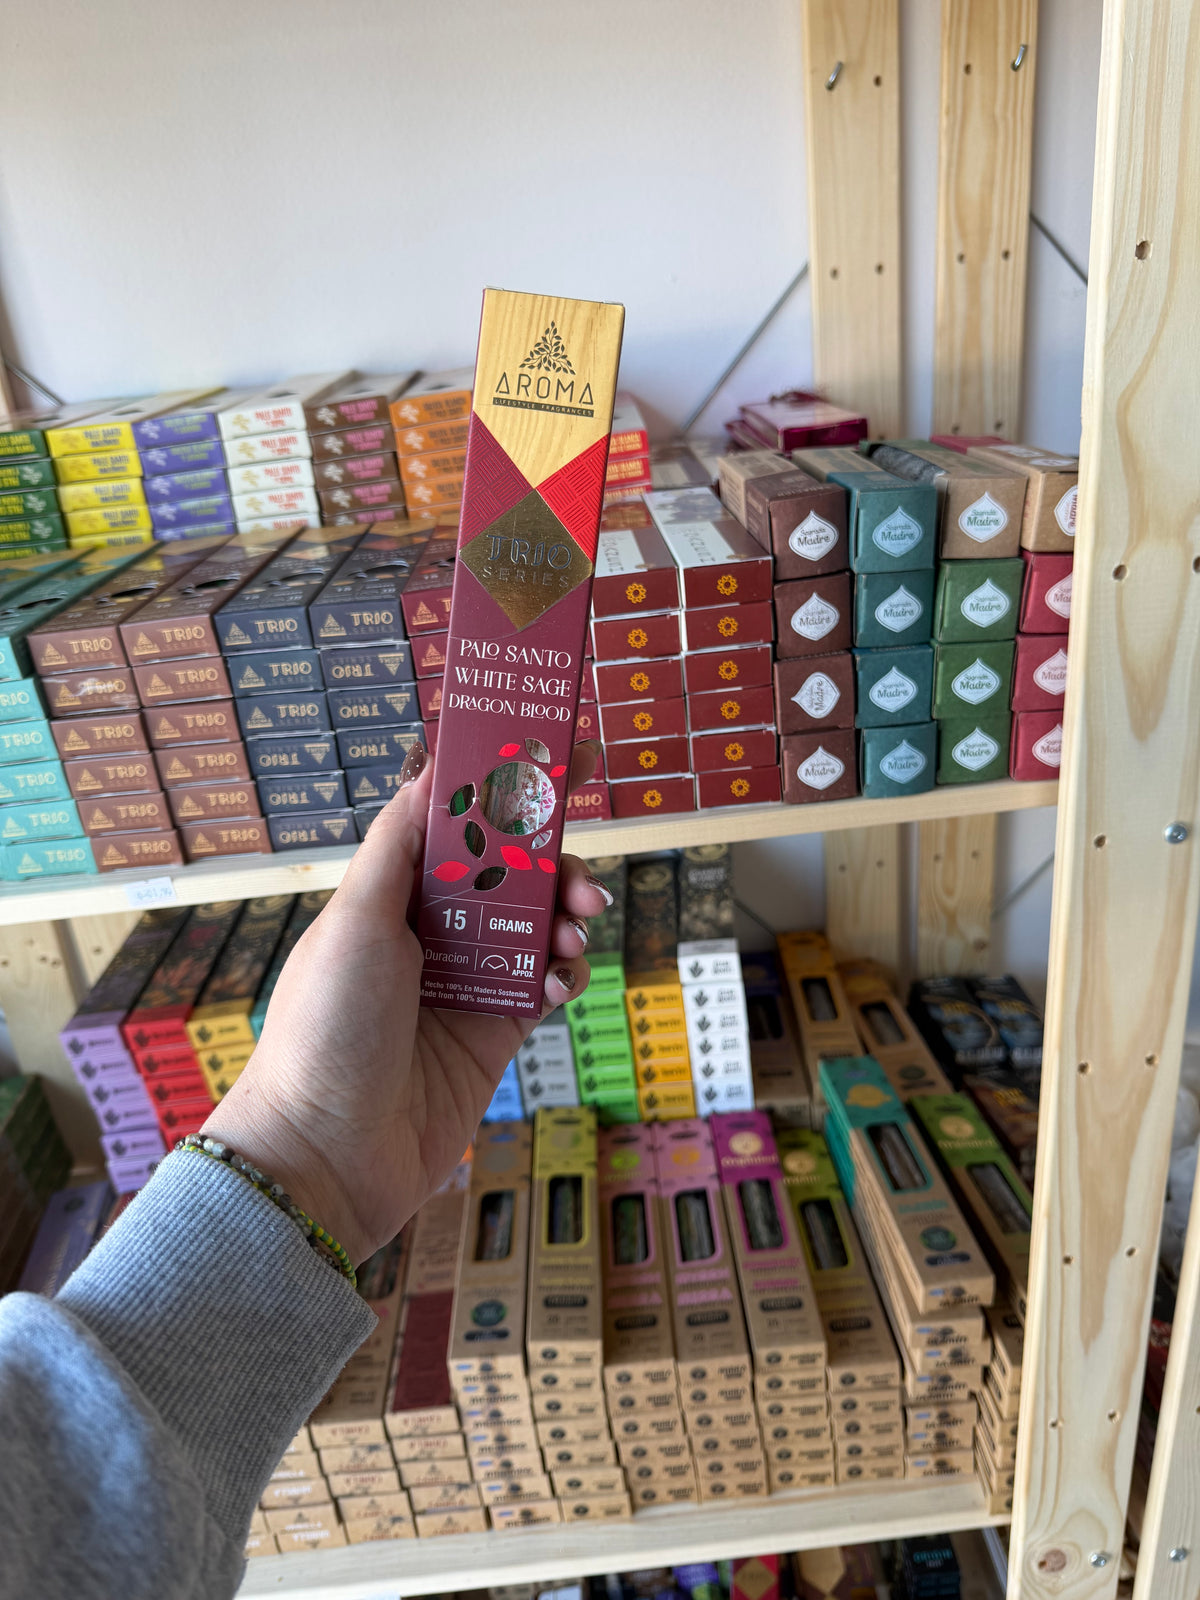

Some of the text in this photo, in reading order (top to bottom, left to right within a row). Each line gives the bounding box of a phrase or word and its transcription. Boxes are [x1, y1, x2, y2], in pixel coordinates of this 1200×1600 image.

[495, 371, 593, 405] AROMA
[494, 398, 592, 416] LIFESTYLE FRAGRANCES
[966, 516, 1000, 527] Madre
[797, 535, 831, 547] Madre
[881, 531, 915, 542] Madre
[486, 534, 572, 569] TRIO
[482, 565, 570, 588] SERIES
[883, 608, 915, 619] Madre
[969, 602, 1001, 612] Madre
[254, 618, 298, 634] TRIO
[350, 611, 394, 627] TRIO
[799, 615, 831, 627] Madre
[161, 625, 205, 643] TRIO
[67, 637, 113, 654] TRIO
[460, 639, 571, 669] PALO SANTO
[174, 667, 219, 684] TRIO
[268, 660, 312, 677] TRIO
[331, 663, 375, 679] TRIO
[455, 666, 572, 697] WHITE SAGE
[960, 681, 992, 690] Madre
[0, 691, 29, 706] RIO
[814, 680, 823, 711] Madre
[877, 688, 909, 699] Madre
[276, 703, 319, 718] TRIO
[339, 703, 381, 719] TRIO
[448, 693, 516, 716] DRAGON
[520, 702, 571, 722] BLOOD
[183, 711, 227, 728] TRIO
[1, 731, 43, 748] TRIO
[90, 724, 135, 740] TRIO
[348, 743, 390, 758] TRIO
[960, 748, 992, 758] Madre
[194, 752, 237, 768] TRIO
[259, 752, 301, 767] TRIO
[887, 760, 919, 771] Madre
[15, 771, 56, 788] TRIO
[104, 764, 147, 780] TRIO
[804, 766, 836, 777] Madre
[206, 791, 249, 807] TRIO
[269, 791, 310, 806] TRIO
[28, 811, 70, 827] TRIO
[116, 803, 159, 819] TRIO
[219, 827, 260, 843] TRIO
[279, 828, 321, 844] TRIO
[45, 848, 86, 863] TRIO
[129, 840, 172, 855] TRIO
[442, 908, 534, 934] 15 GRAMS
[424, 949, 469, 965] Duracion
[514, 953, 535, 971] 1H
[511, 969, 535, 978] APPOX.
[438, 991, 454, 1000] from
[456, 993, 475, 1003] 100%
[476, 995, 515, 1007] sustainable
[516, 1001, 535, 1009] wood
[473, 986, 497, 995] Madera
[497, 988, 530, 999] Sostenible
